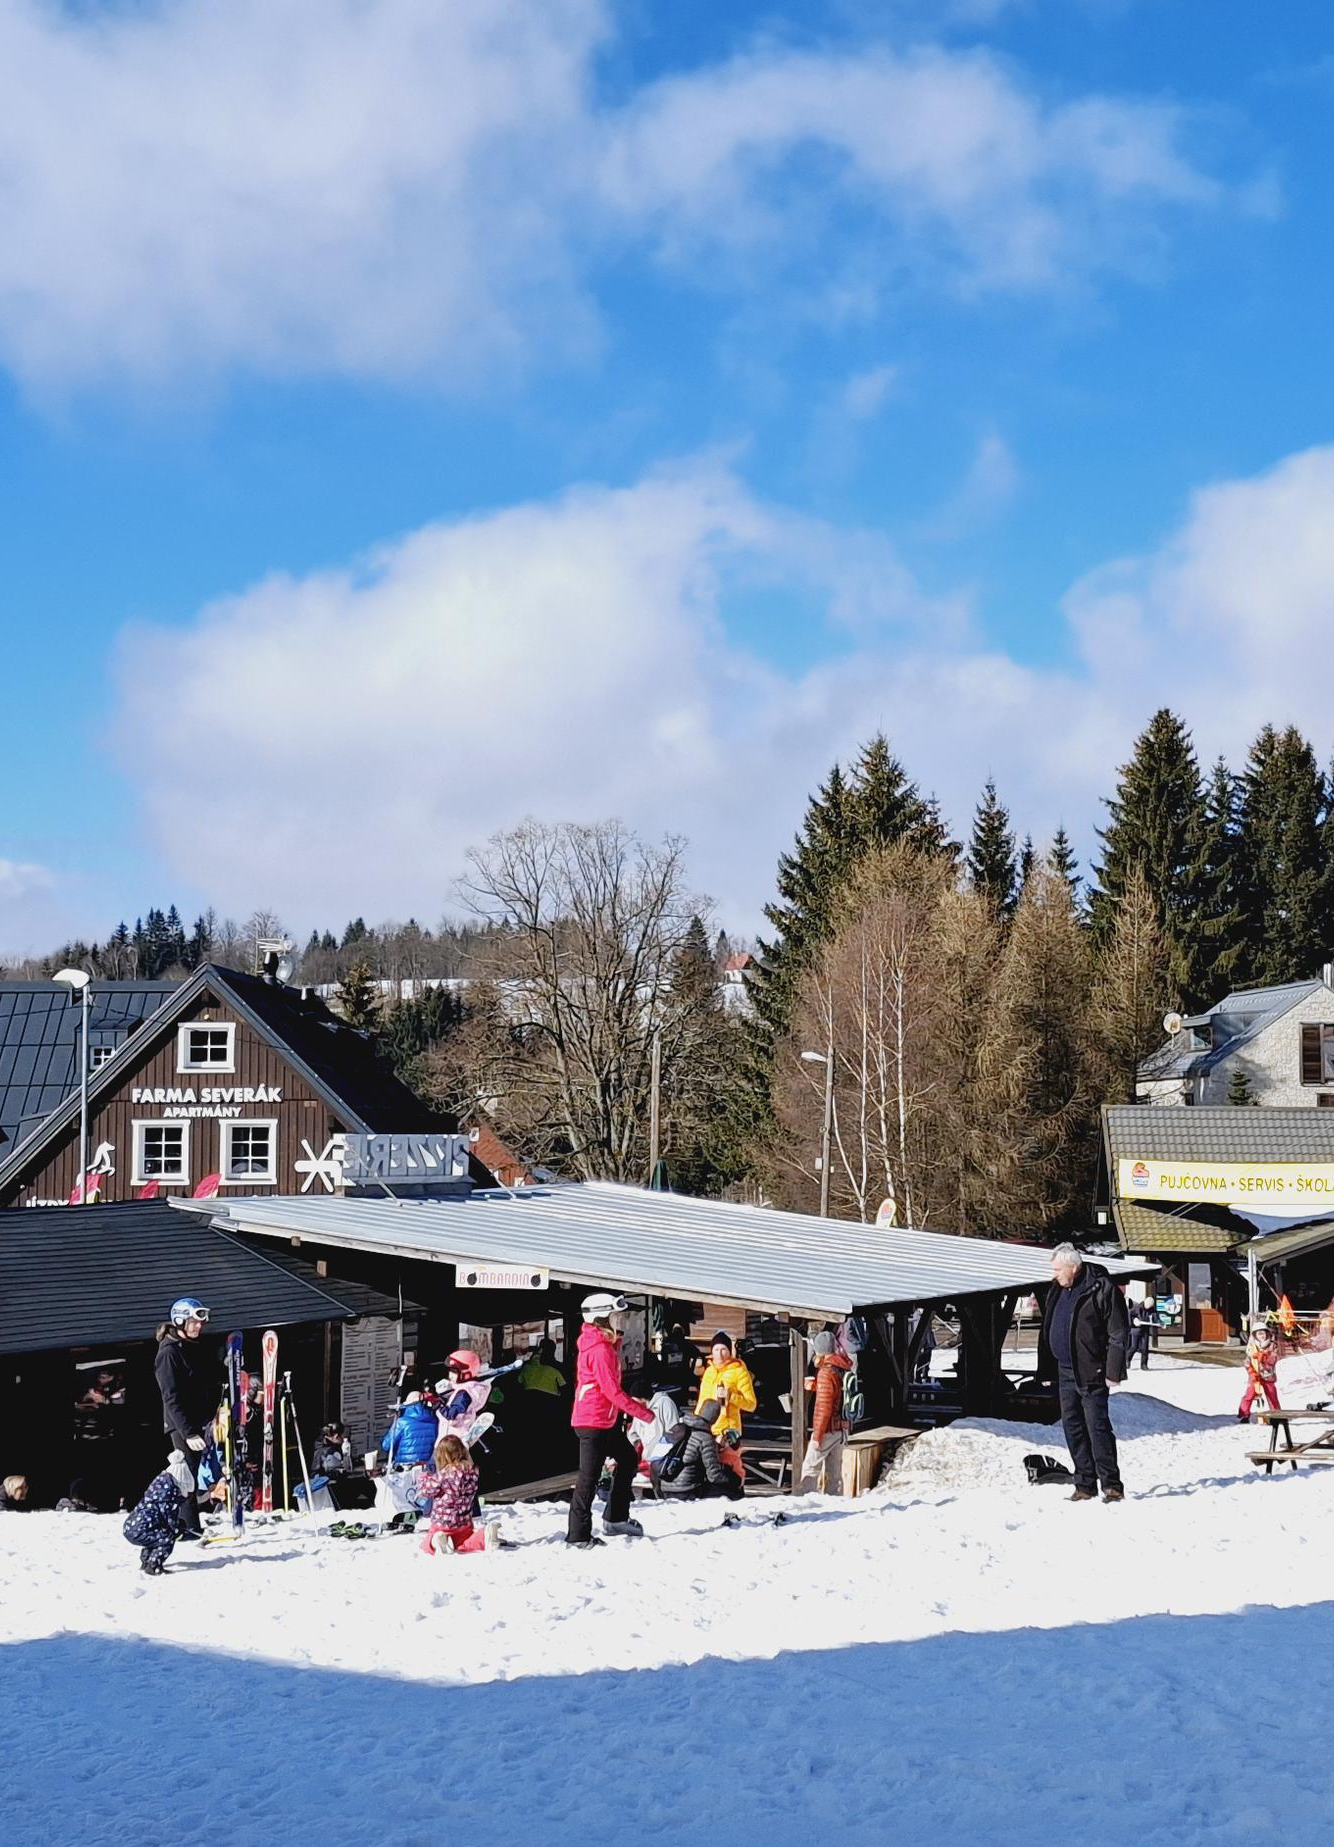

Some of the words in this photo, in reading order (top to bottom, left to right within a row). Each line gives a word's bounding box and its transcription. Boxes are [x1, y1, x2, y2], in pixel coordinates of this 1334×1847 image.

[132, 1087, 196, 1103] FARMA
[200, 1083, 283, 1103] SEVERÁK
[163, 1104, 242, 1118] APARTMÁNY
[1239, 1177, 1285, 1193] SERVIS
